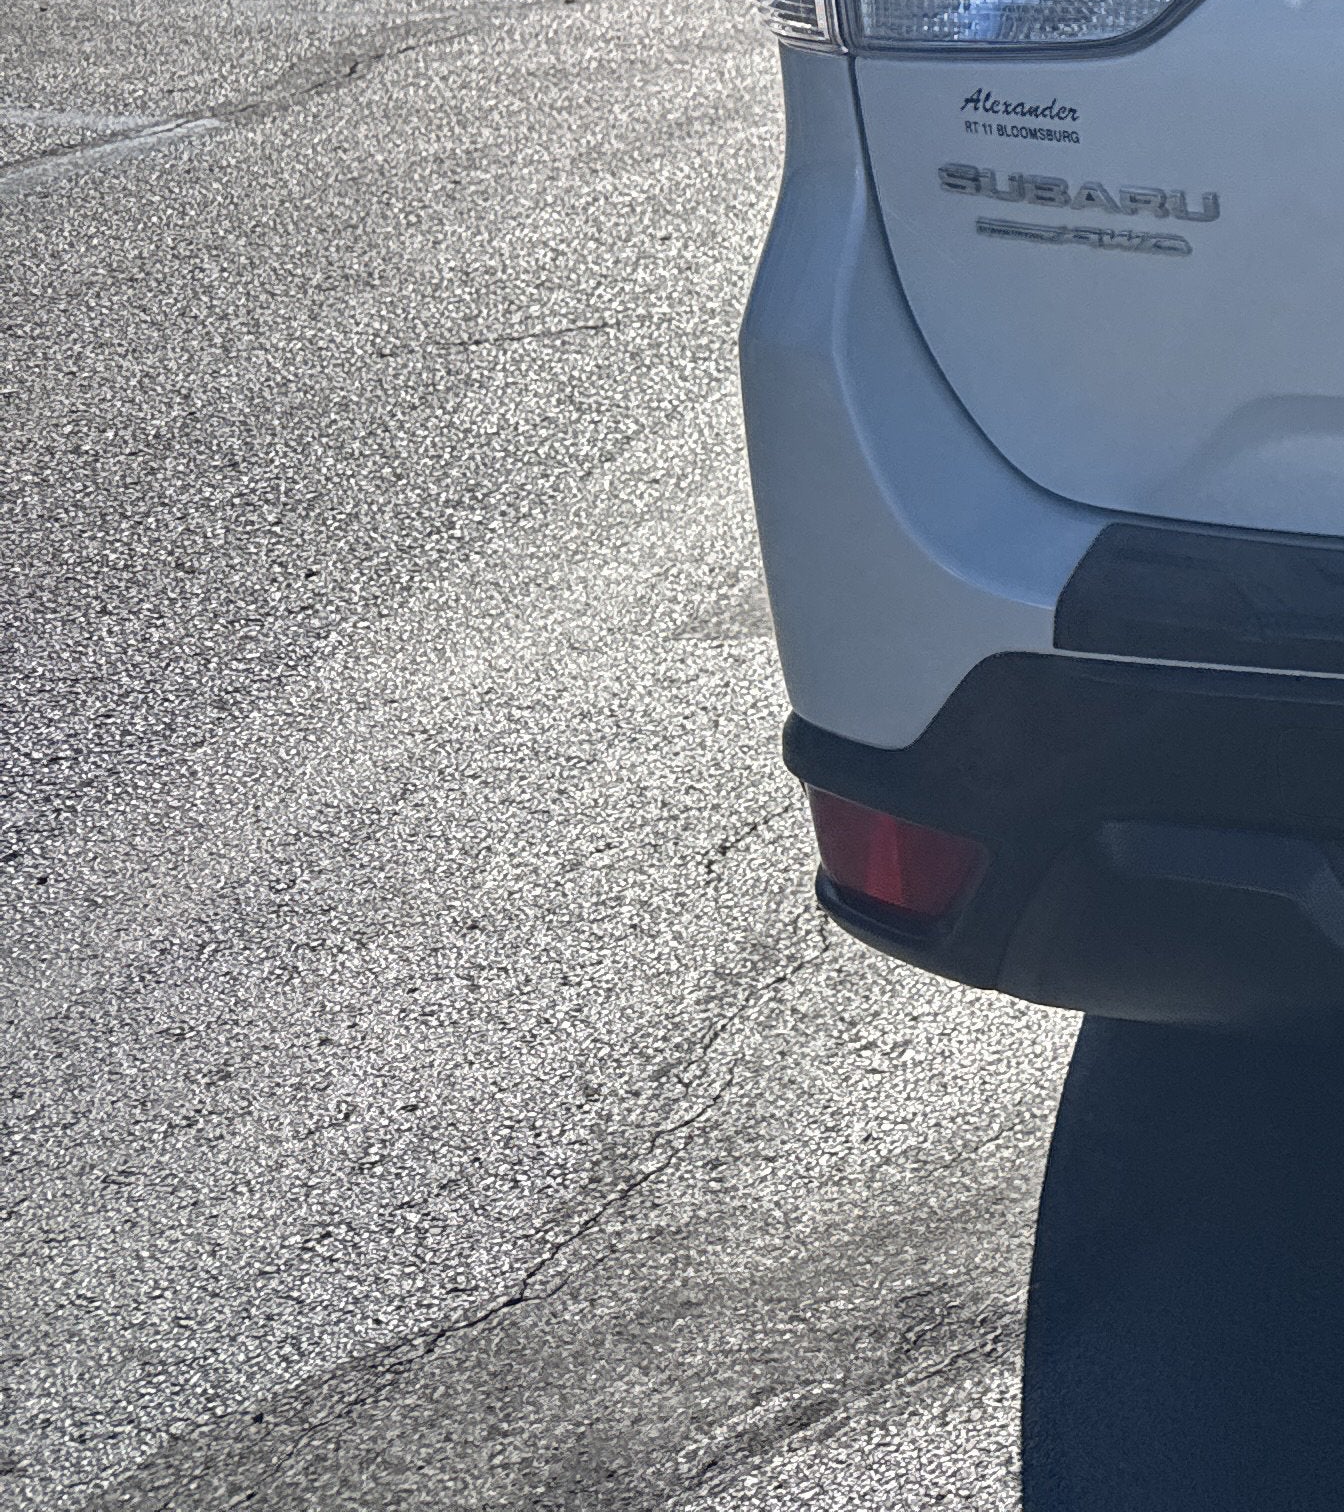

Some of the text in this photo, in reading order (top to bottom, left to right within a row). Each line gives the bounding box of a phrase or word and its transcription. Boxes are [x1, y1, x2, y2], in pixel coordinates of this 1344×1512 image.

[960, 87, 1080, 122] Alexander
[964, 120, 1080, 144] RT 11 BLOOMSBURG
[938, 162, 1221, 223] SUBARU
